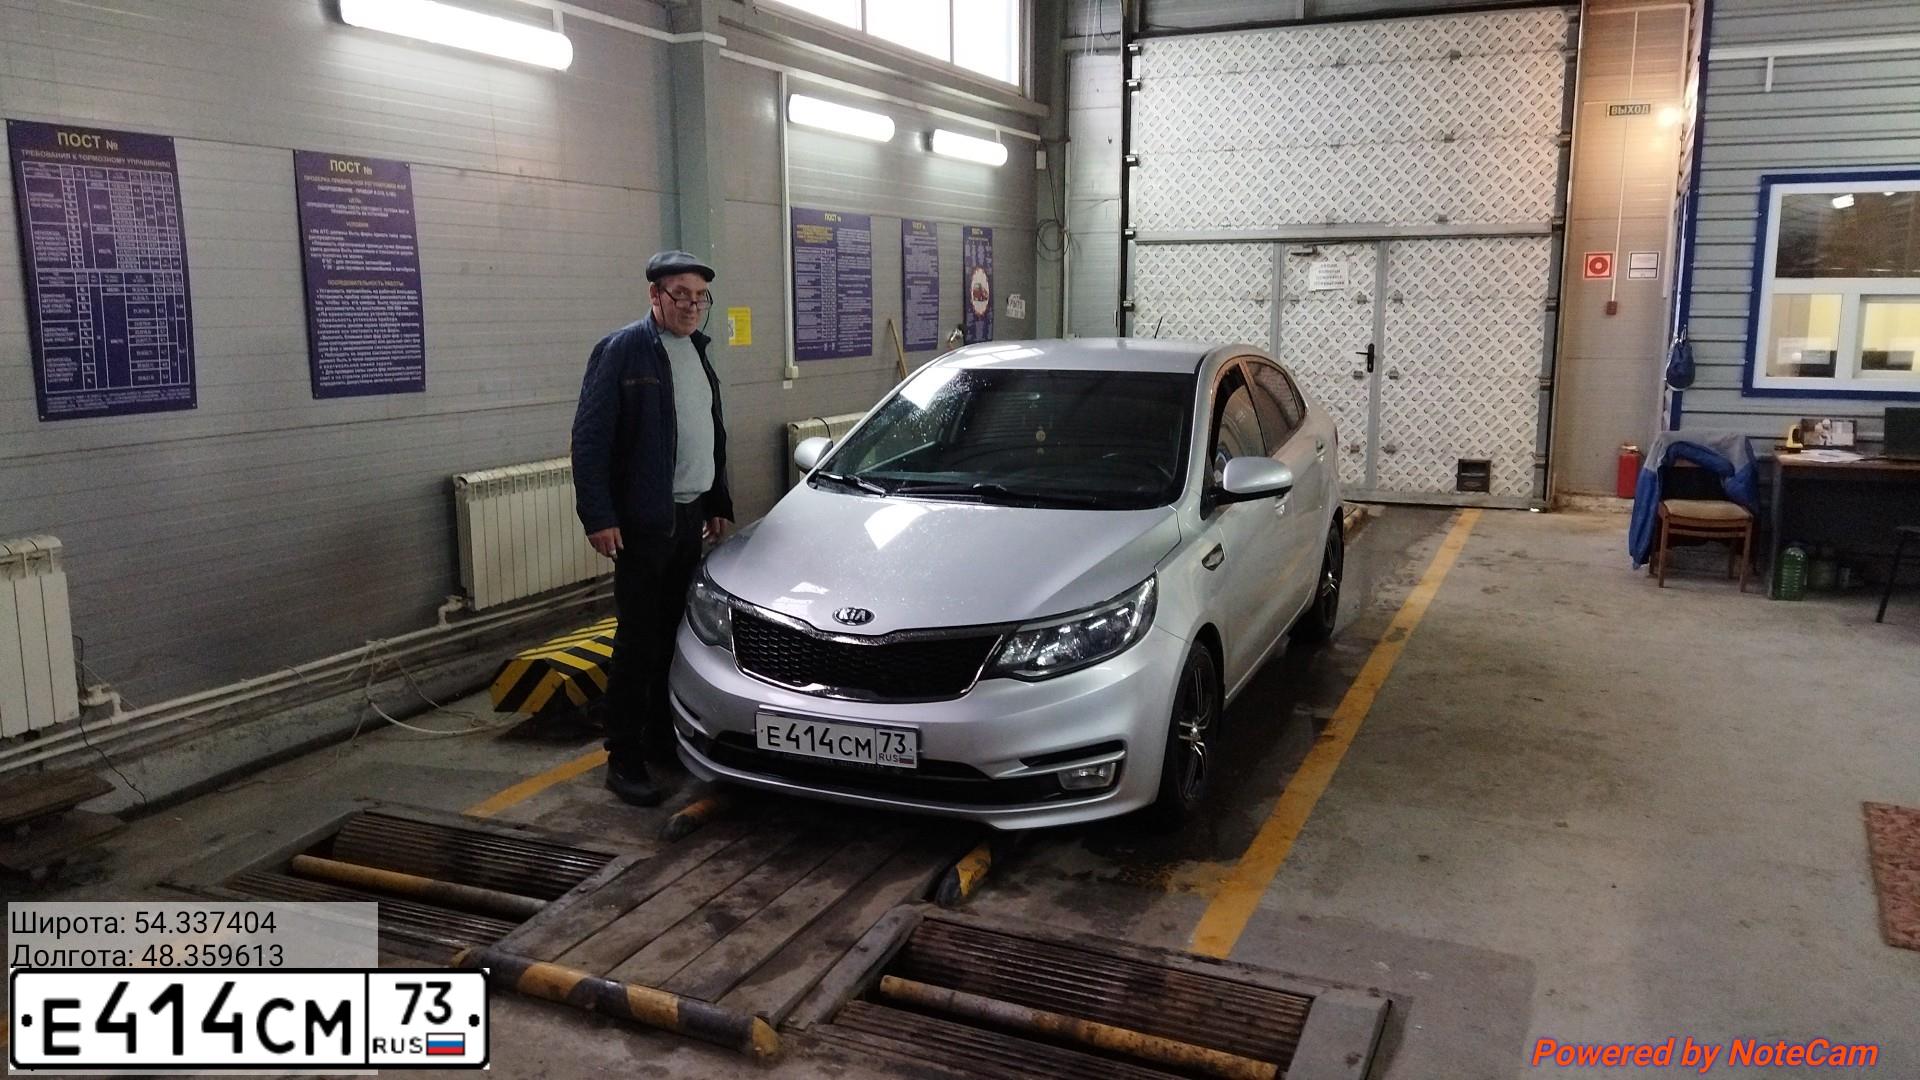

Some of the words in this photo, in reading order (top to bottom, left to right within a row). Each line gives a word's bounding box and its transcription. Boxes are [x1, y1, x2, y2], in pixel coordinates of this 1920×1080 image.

[1611, 105, 1649, 115] ВЫХОД
[57, 131, 101, 149] ПОСТ
[105, 140, 119, 151] №
[21, 149, 71, 160] ТРЕБОВАНИЯ
[78, 153, 126, 164] ТОРМОЗНОМУ
[127, 157, 171, 168] УПРАВЛЕНИЮ
[330, 159, 360, 173] ПОСТ
[363, 166, 373, 175] №
[767, 723, 871, 759] Е414СМ
[879, 732, 906, 754] 73
[878, 752, 898, 763] RUS
